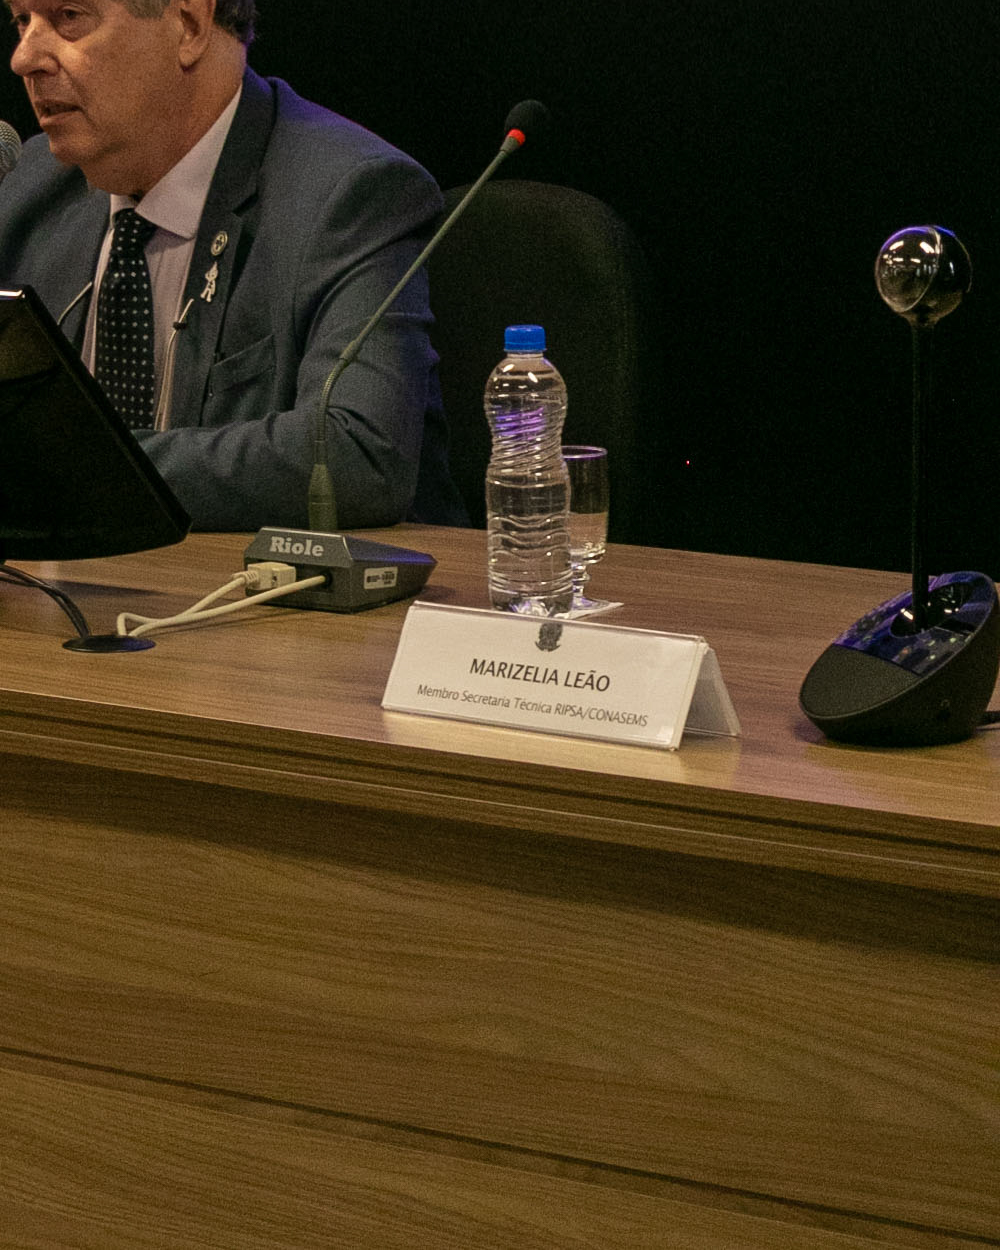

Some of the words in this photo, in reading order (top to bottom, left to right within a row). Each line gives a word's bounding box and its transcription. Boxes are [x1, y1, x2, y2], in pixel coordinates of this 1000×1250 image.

[269, 536, 325, 557] Riole
[469, 657, 560, 687] MARIZELIA
[563, 668, 612, 692] LEÃO
[416, 684, 460, 701] Membro
[460, 690, 511, 709] Secretaria
[553, 702, 650, 728] RIPSA/CONASEMS
